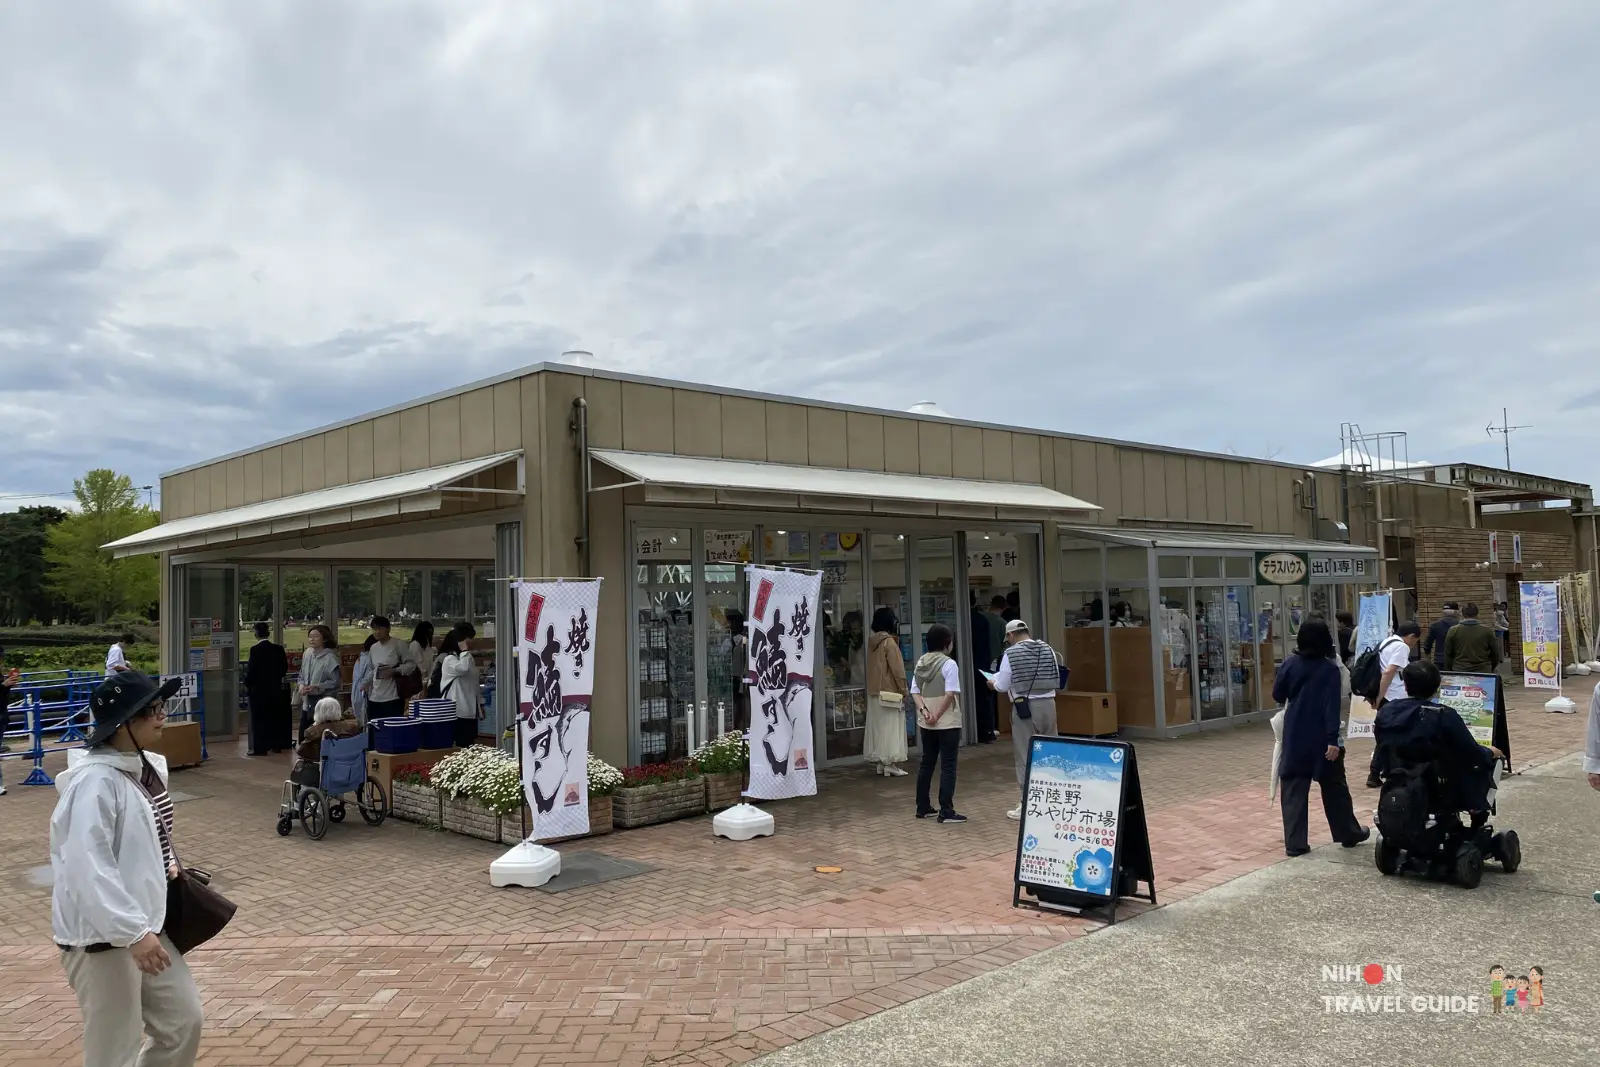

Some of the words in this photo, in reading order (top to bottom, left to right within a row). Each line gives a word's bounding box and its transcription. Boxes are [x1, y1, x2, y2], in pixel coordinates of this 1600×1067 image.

[637, 539, 662, 554] 会計
[1263, 560, 1303, 574] テラスハウス
[789, 595, 810, 660] 焼き
[565, 606, 590, 678] 焼き
[1028, 786, 1082, 807] 常陸野
[1027, 804, 1117, 828] みやげ市場
